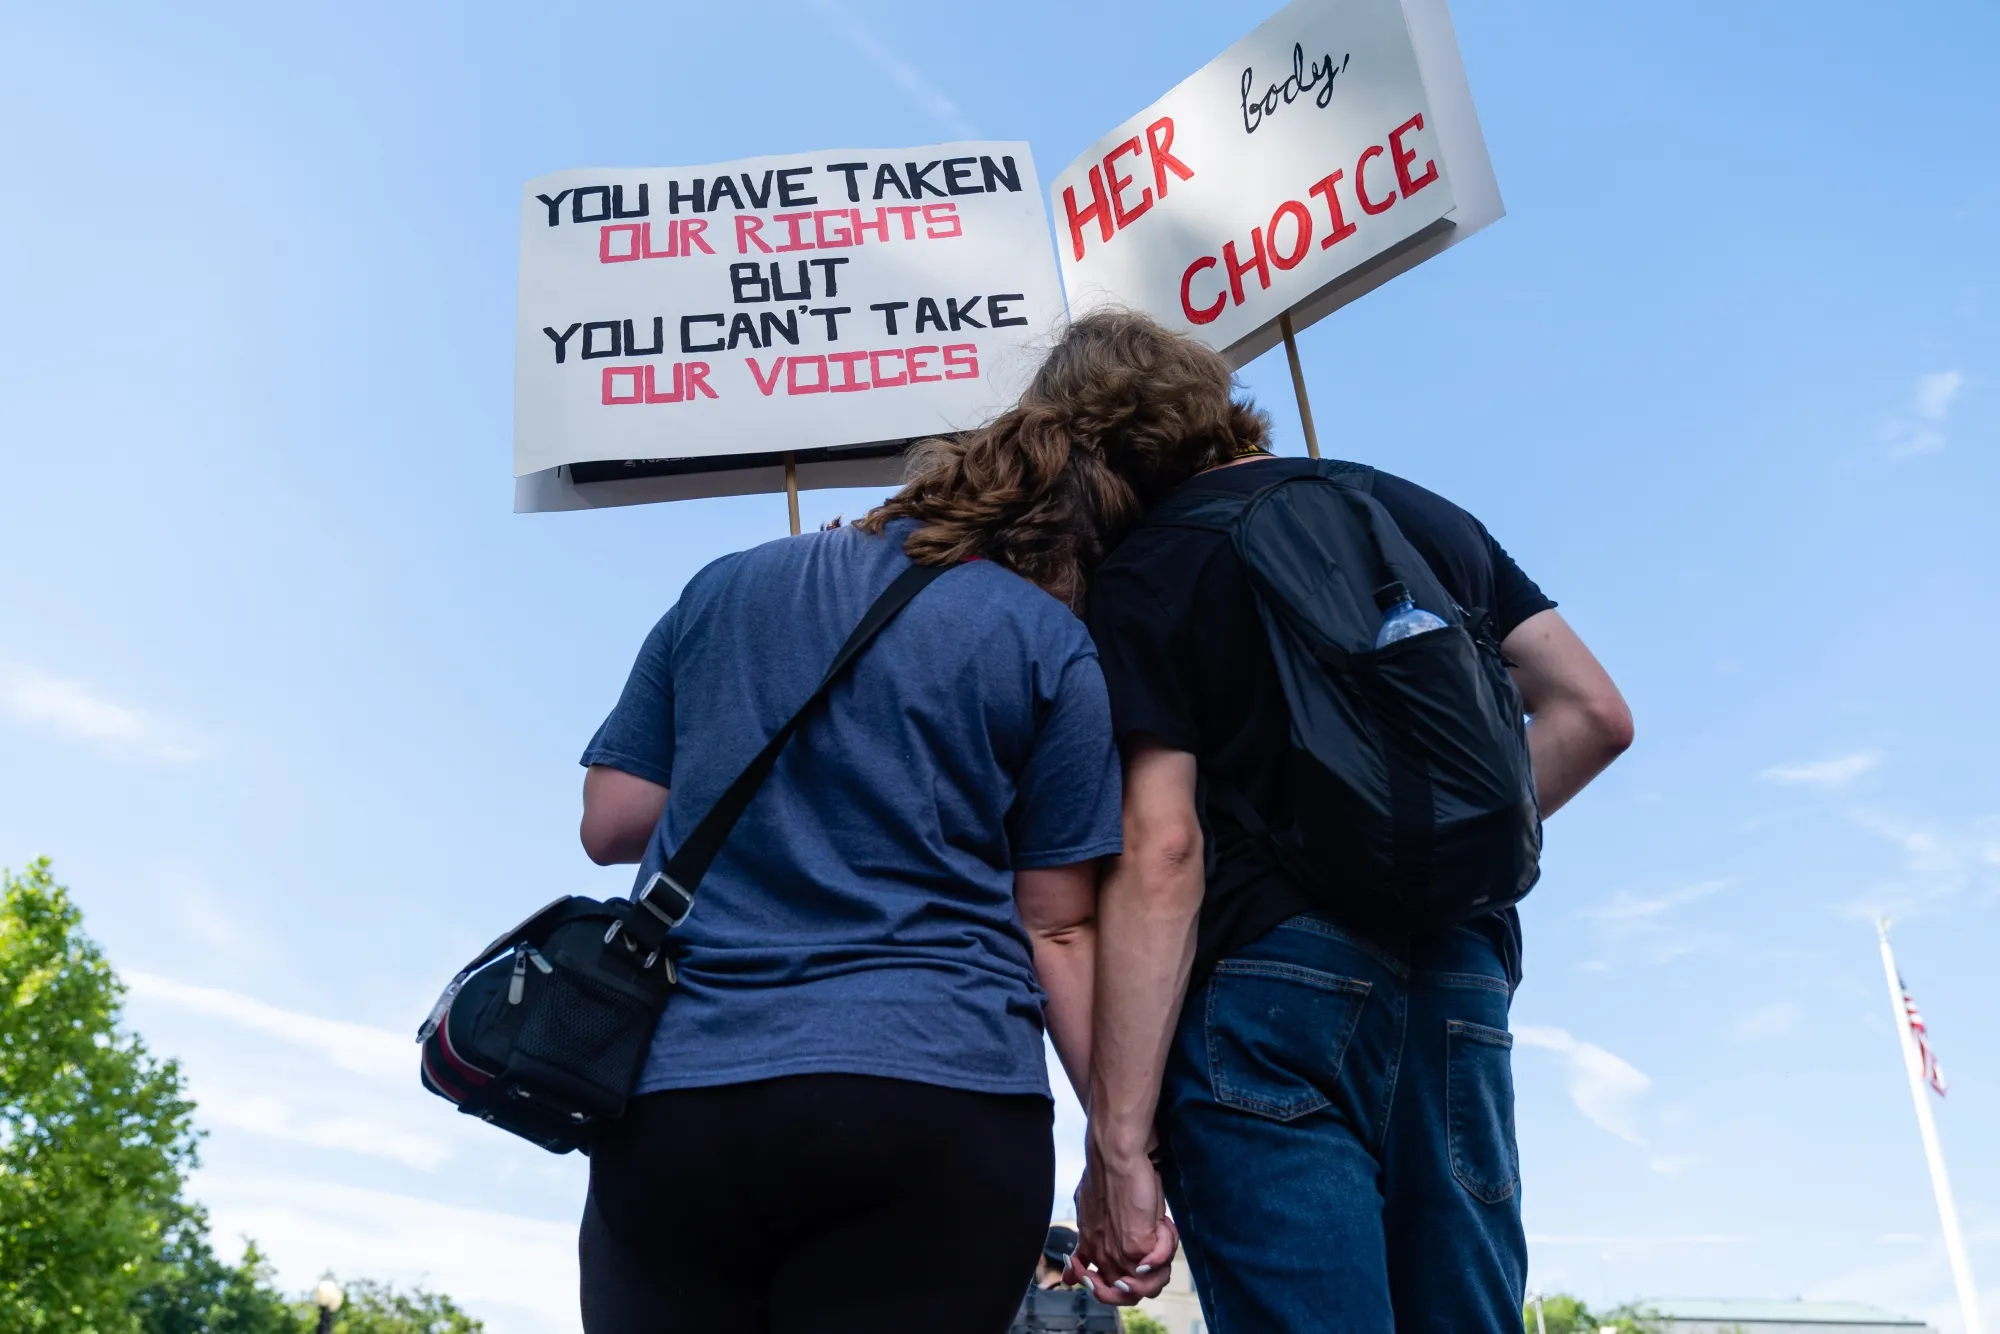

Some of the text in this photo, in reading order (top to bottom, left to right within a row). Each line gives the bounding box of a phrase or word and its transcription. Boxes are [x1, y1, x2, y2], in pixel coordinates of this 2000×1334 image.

[1062, 42, 1350, 262] HER body,
[535, 155, 1022, 227] YOU HAVE TAKEN
[1180, 113, 1439, 325] CHOICE
[599, 202, 963, 265] OUR RIGHTS
[729, 257, 850, 304] BUT
[542, 293, 1028, 364] YOU CAN'T TAKE
[601, 343, 979, 406] OUR VOICES
